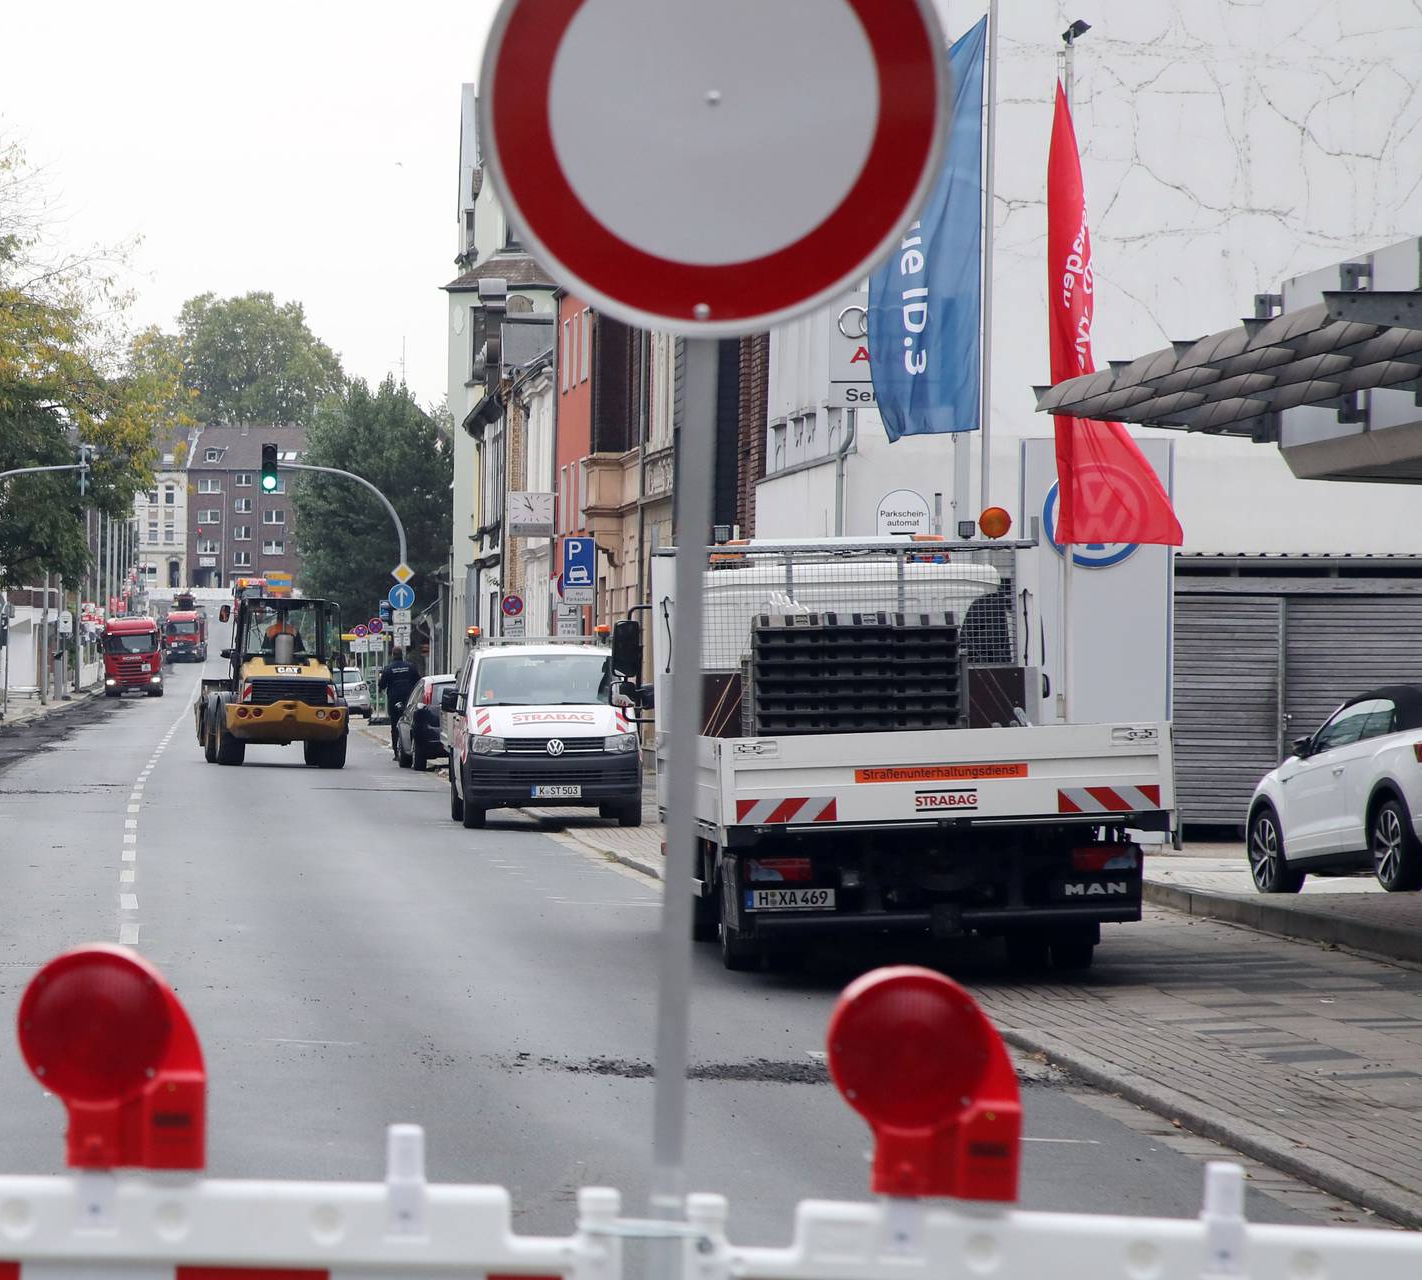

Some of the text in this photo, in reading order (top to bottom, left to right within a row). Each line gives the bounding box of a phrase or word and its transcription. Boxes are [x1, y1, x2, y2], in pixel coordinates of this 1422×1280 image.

[902, 287, 929, 376] ID.3
[568, 541, 582, 561] P
[512, 713, 595, 721] STRABAG
[862, 764, 1020, 780] Straßenunterhaltungsdienst
[539, 786, 578, 795] K ST 503
[915, 794, 978, 807] STRABAG
[1065, 882, 1127, 896] MAN
[759, 890, 828, 906] H XA 469
